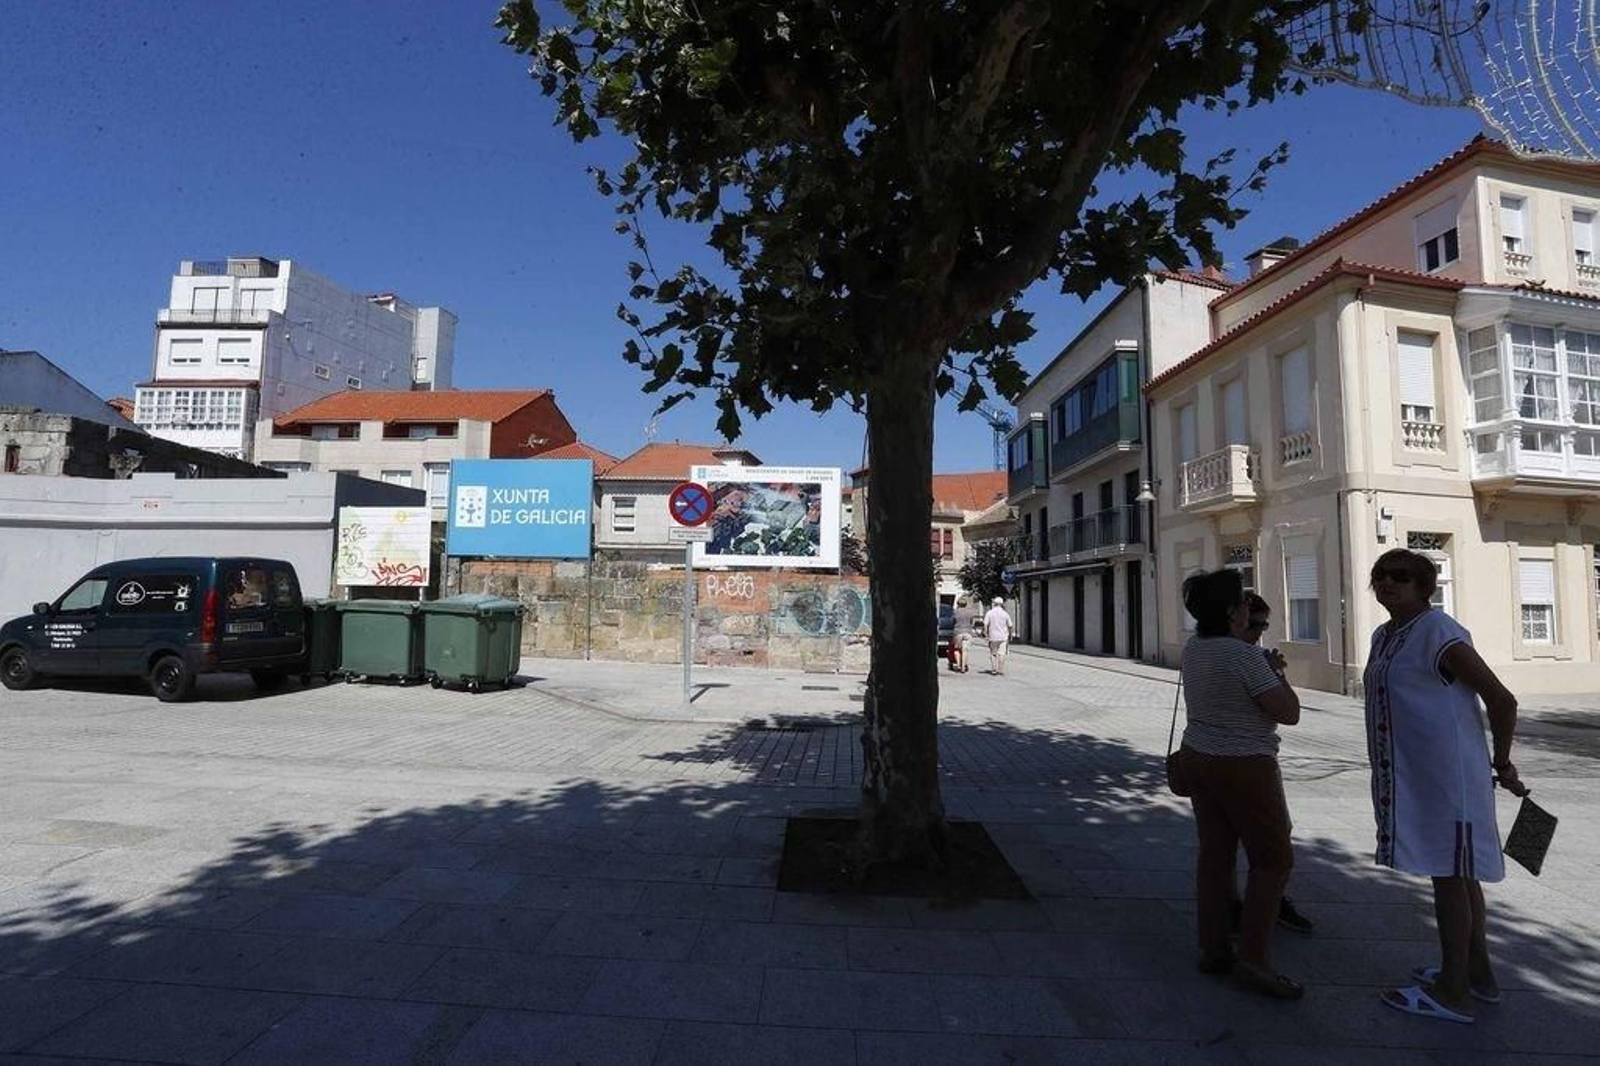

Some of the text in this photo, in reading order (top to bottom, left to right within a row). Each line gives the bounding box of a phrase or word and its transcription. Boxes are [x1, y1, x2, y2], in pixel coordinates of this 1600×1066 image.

[492, 489, 550, 504] XUNTA
[490, 509, 586, 525] DE GALICIA
